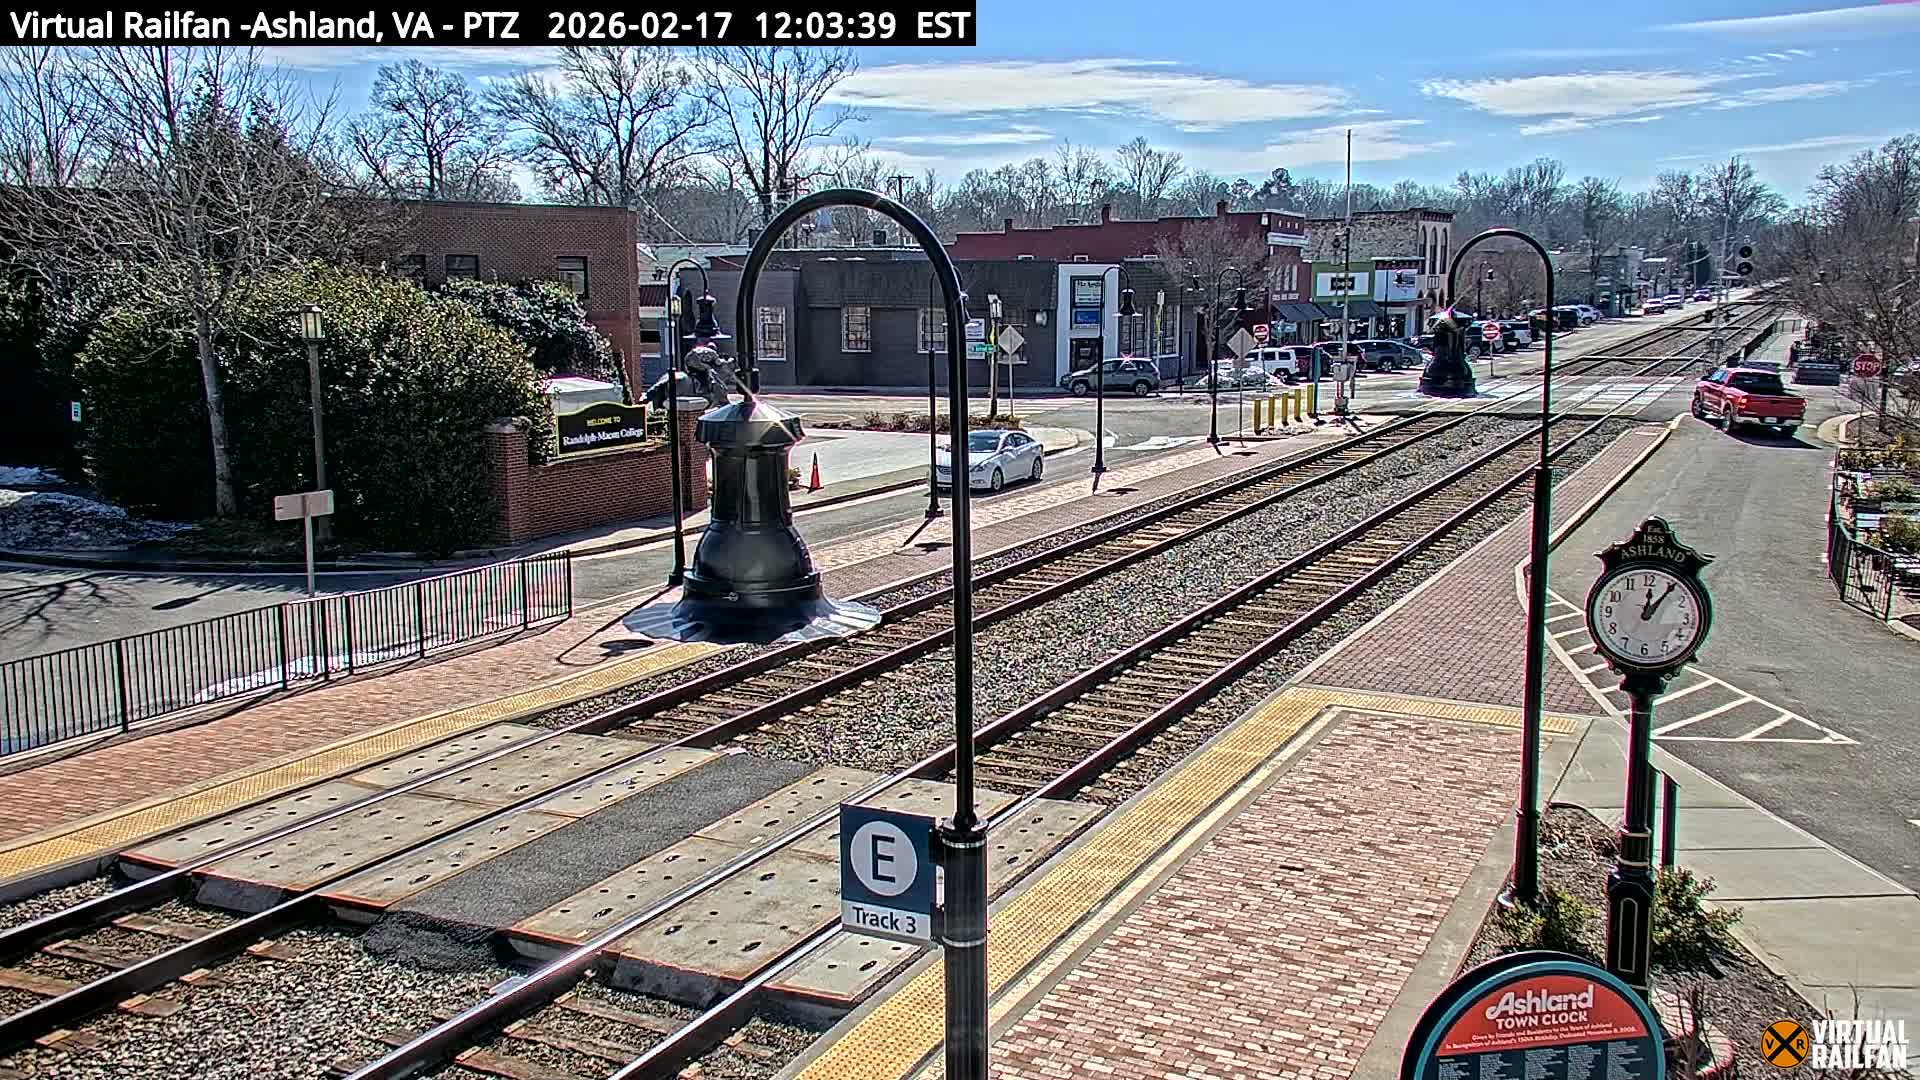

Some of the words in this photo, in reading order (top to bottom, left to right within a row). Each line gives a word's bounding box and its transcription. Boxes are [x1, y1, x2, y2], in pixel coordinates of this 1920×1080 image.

[1855, 361, 1880, 371] STOP
[586, 417, 612, 427] WELCOME
[562, 430, 620, 447] Randolph-Macon
[620, 427, 644, 438] College
[1643, 534, 1665, 544] 1858
[1621, 545, 1686, 563] ASHLAND
[1625, 576, 1635, 590] 11
[1643, 575, 1656, 588] 12
[1610, 591, 1621, 603] 10
[1679, 596, 1686, 608] 2
[1605, 606, 1612, 618] 9
[1682, 613, 1689, 625] 3
[1608, 622, 1617, 635] 8
[1621, 637, 1629, 650] 7
[1640, 643, 1649, 655] 6
[1661, 640, 1669, 652] 5
[871, 833, 896, 883] E
[852, 906, 900, 931] Track
[905, 916, 917, 934] 3
[1485, 984, 1594, 1020] Ashland
[1496, 1014, 1539, 1030] TOWN
[1543, 1011, 1589, 1026] CLOCK
